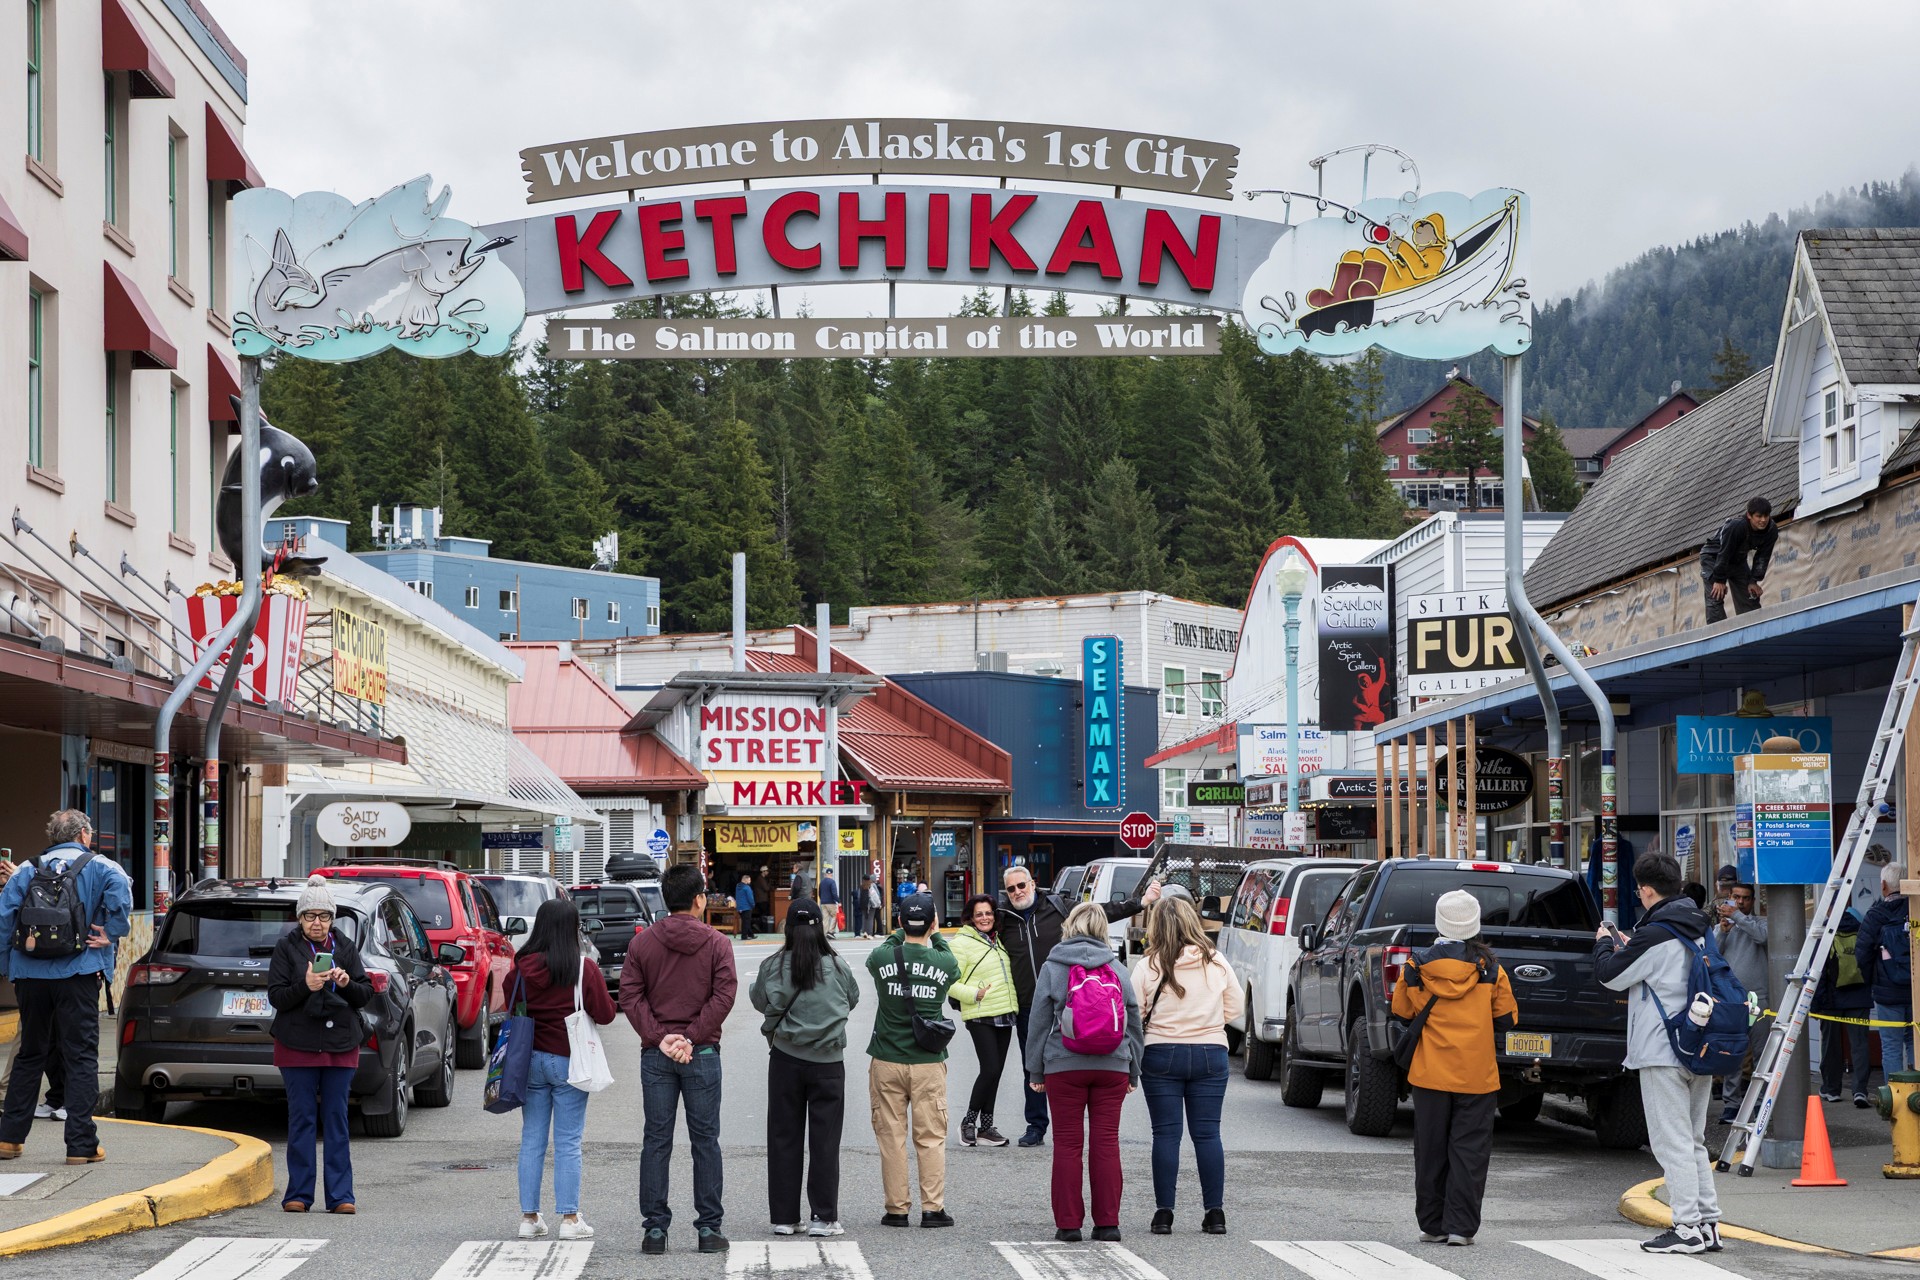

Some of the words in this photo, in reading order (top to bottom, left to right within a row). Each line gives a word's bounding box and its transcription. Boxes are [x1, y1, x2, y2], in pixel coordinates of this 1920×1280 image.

[540, 139, 757, 186] Welcome
[769, 128, 819, 162] to
[832, 122, 1026, 163] Alaska's
[1042, 131, 1111, 170] 1st
[1124, 137, 1218, 193] City
[554, 191, 1222, 293] KETCHIKAN
[563, 325, 636, 351] The
[655, 325, 796, 351] Salmon
[815, 324, 948, 356] Capital
[966, 325, 1002, 350] of
[1018, 325, 1077, 349] the
[1094, 323, 1204, 348] World
[1173, 622, 1198, 648] TOM'S
[1416, 616, 1515, 669] FUR
[1328, 639, 1352, 650] Arctic
[1337, 650, 1362, 663] Spirit
[333, 648, 362, 697] TROLLEY
[1348, 660, 1377, 673] Gallery
[365, 666, 386, 704] CENTER
[1419, 675, 1517, 691] GALLER
[701, 706, 826, 732] MISSION
[1089, 641, 1112, 802] SEAMAX
[1260, 730, 1301, 740] Salm
[1304, 730, 1324, 739] Etc.
[708, 738, 823, 763] STREET
[1690, 754, 1734, 762] DIAMO
[1265, 763, 1320, 774] SALON
[1335, 781, 1366, 793] Arctic
[1367, 781, 1391, 793] Sir
[1398, 781, 1428, 793] Gler
[1438, 777, 1465, 791] FR
[733, 780, 867, 806] MARKET
[1457, 799, 1509, 810] KCHIKAN
[344, 806, 380, 825] SALTY
[1322, 810, 1344, 818] Arctic
[1123, 824, 1155, 838] STOP
[1331, 818, 1352, 828] Spirit
[350, 824, 387, 842] SIREN
[719, 825, 791, 844] SALMON
[1340, 827, 1366, 837] Gallery
[879, 962, 909, 980] DONT
[912, 962, 949, 986] BLAME
[1523, 967, 1542, 977] Ford
[911, 984, 937, 998] KIDS
